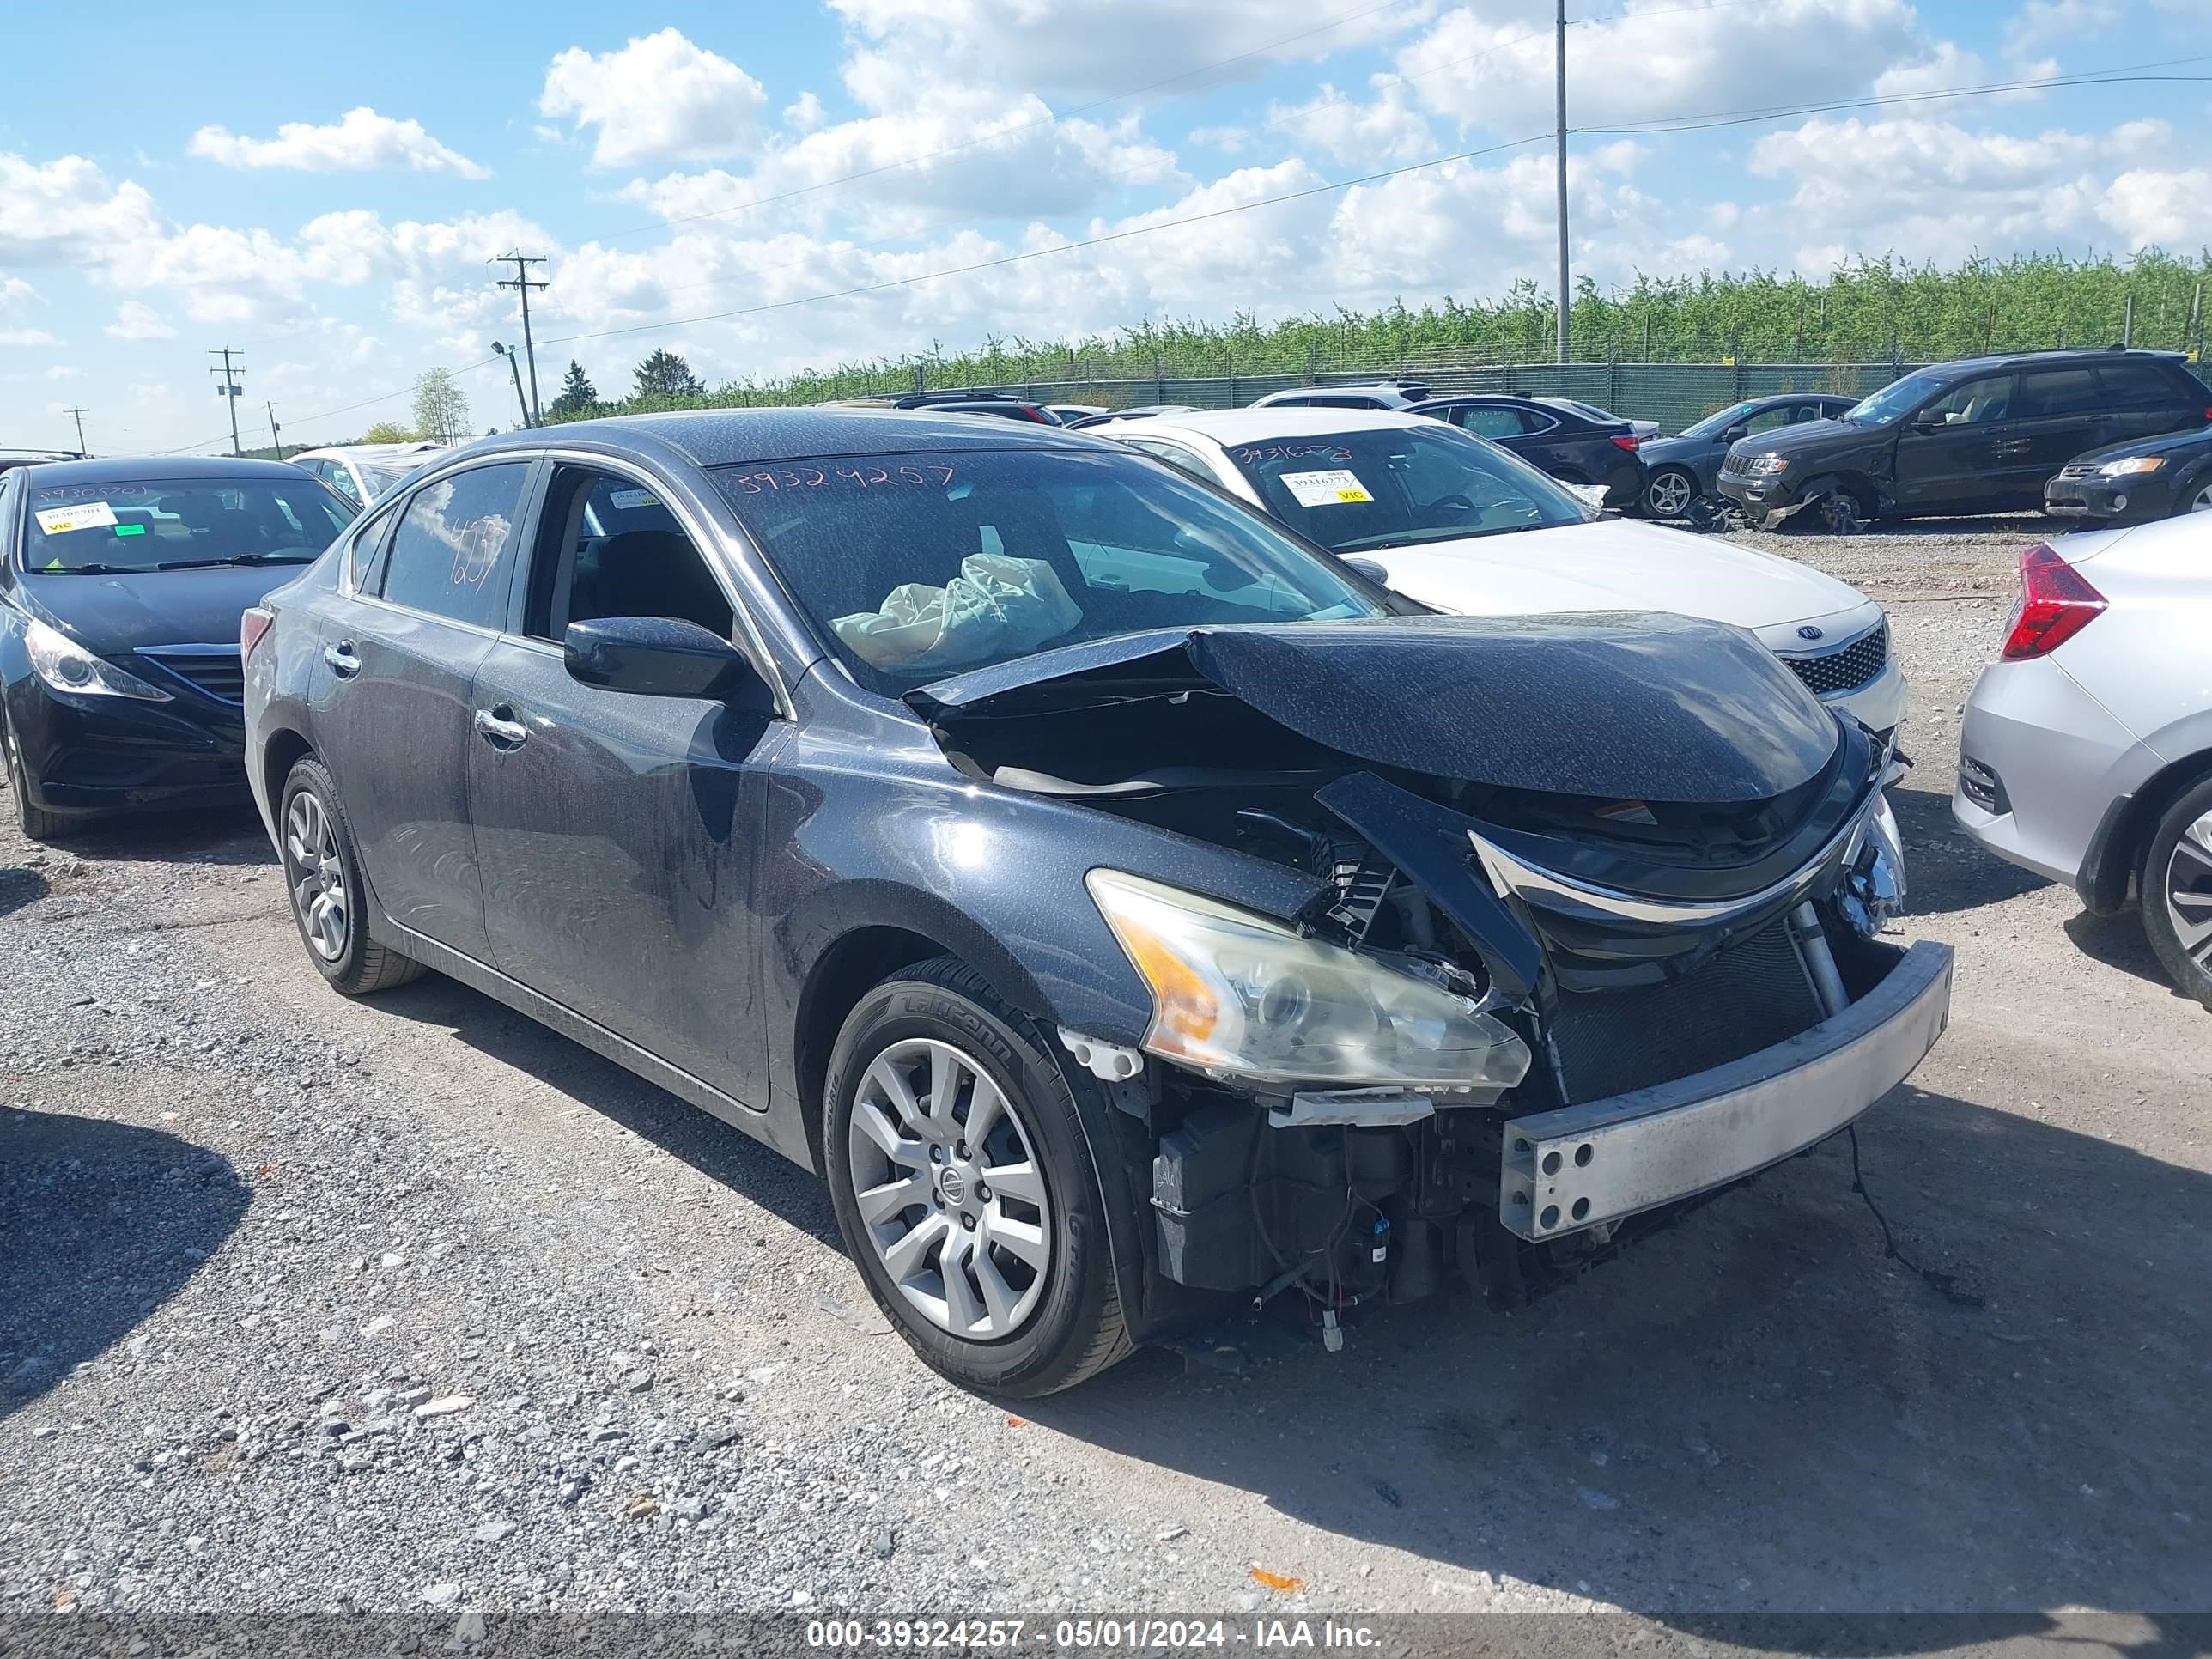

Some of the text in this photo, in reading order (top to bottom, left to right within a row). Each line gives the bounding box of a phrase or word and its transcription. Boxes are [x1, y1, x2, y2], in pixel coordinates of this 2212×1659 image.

[731, 466, 953, 494] 39324257
[1293, 477, 1350, 488] 39316273
[39, 486, 148, 502] 39305701
[1340, 491, 1364, 500] VIC
[49, 522, 73, 531] VIC
[1800, 627, 1822, 638] KIA
